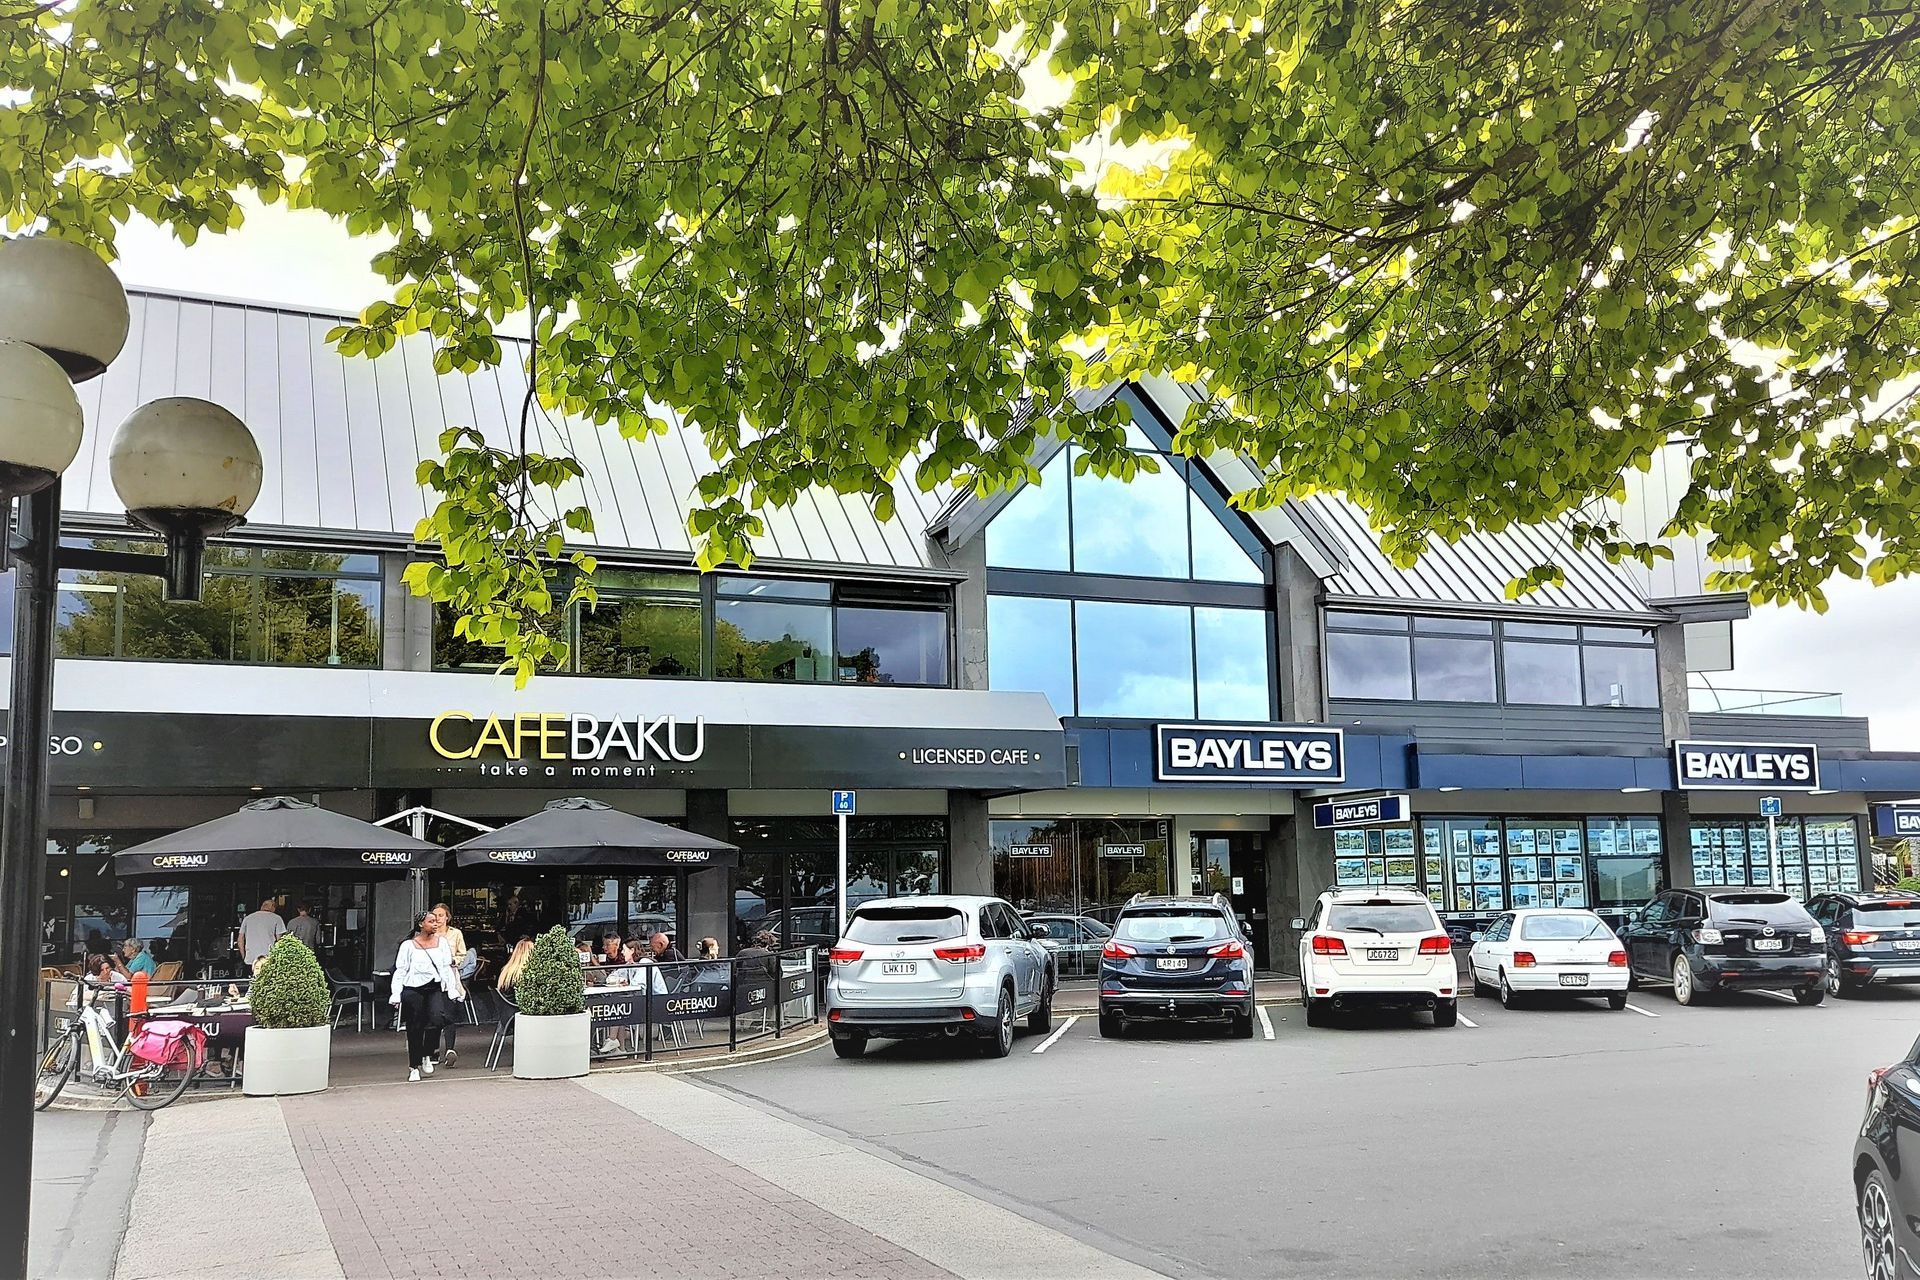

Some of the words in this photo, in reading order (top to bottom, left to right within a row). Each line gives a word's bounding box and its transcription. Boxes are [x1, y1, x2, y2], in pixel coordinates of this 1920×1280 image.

[912, 749, 986, 764] LICENSED
[990, 749, 1028, 764] CAFE
[1171, 738, 1333, 770] BAYLEYS
[480, 763, 528, 776] take
[545, 766, 556, 776] a
[572, 764, 656, 776] moment
[1686, 752, 1809, 780] BAYLEYS
[841, 792, 849, 801] P
[839, 801, 849, 809] 60
[1335, 804, 1377, 820] BAYLEYS
[489, 850, 536, 860] CAFEBAKU
[666, 850, 710, 860] CAFEBAKU
[1012, 847, 1049, 855] BAYLEYS
[1107, 846, 1142, 854] BAYLEYS
[153, 854, 208, 866] CAFEBAKU
[361, 852, 411, 862] CAFEBAKU
[1369, 950, 1397, 958] JCG722
[883, 963, 915, 973] LWK119
[666, 996, 718, 1011] CAFEBAKU
[583, 1003, 632, 1018] AFEBAKU
